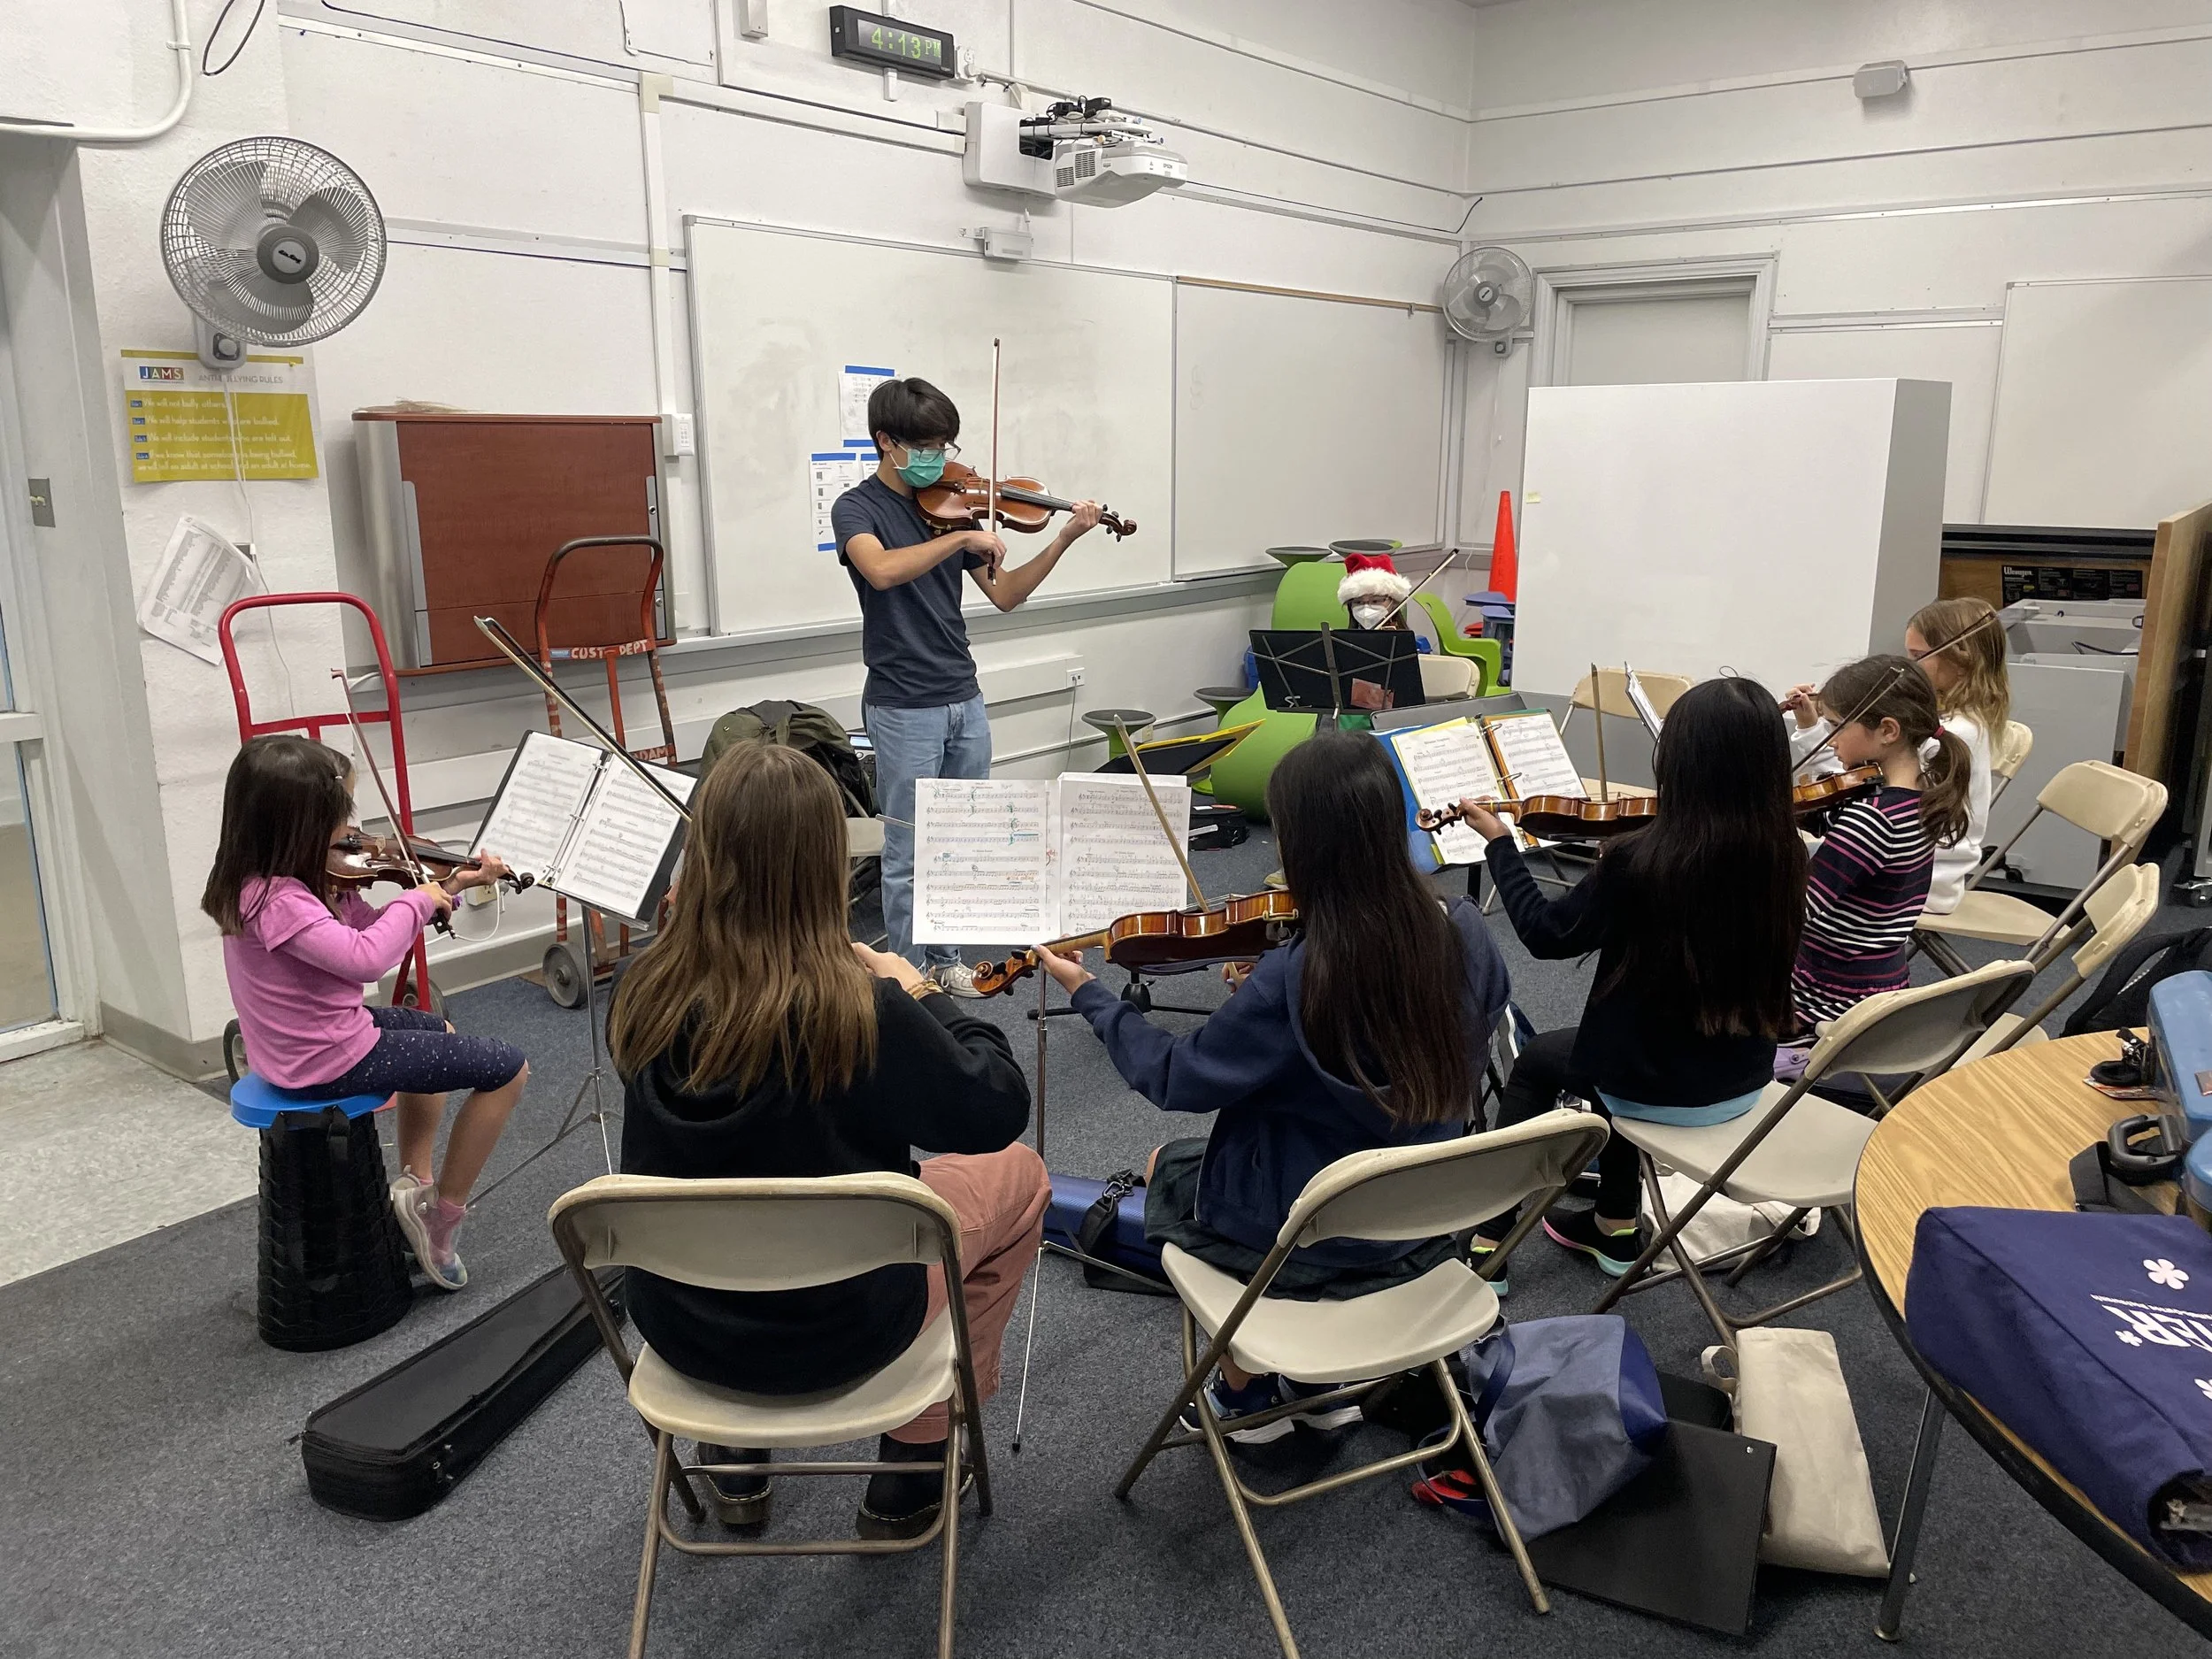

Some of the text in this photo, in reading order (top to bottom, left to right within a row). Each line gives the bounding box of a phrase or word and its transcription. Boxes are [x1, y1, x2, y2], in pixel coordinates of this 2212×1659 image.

[871, 27, 921, 59] 4:13
[142, 366, 182, 380] JAMS
[258, 375, 283, 384] RULES
[571, 647, 603, 659] CUST
[619, 639, 648, 656] DEPT
